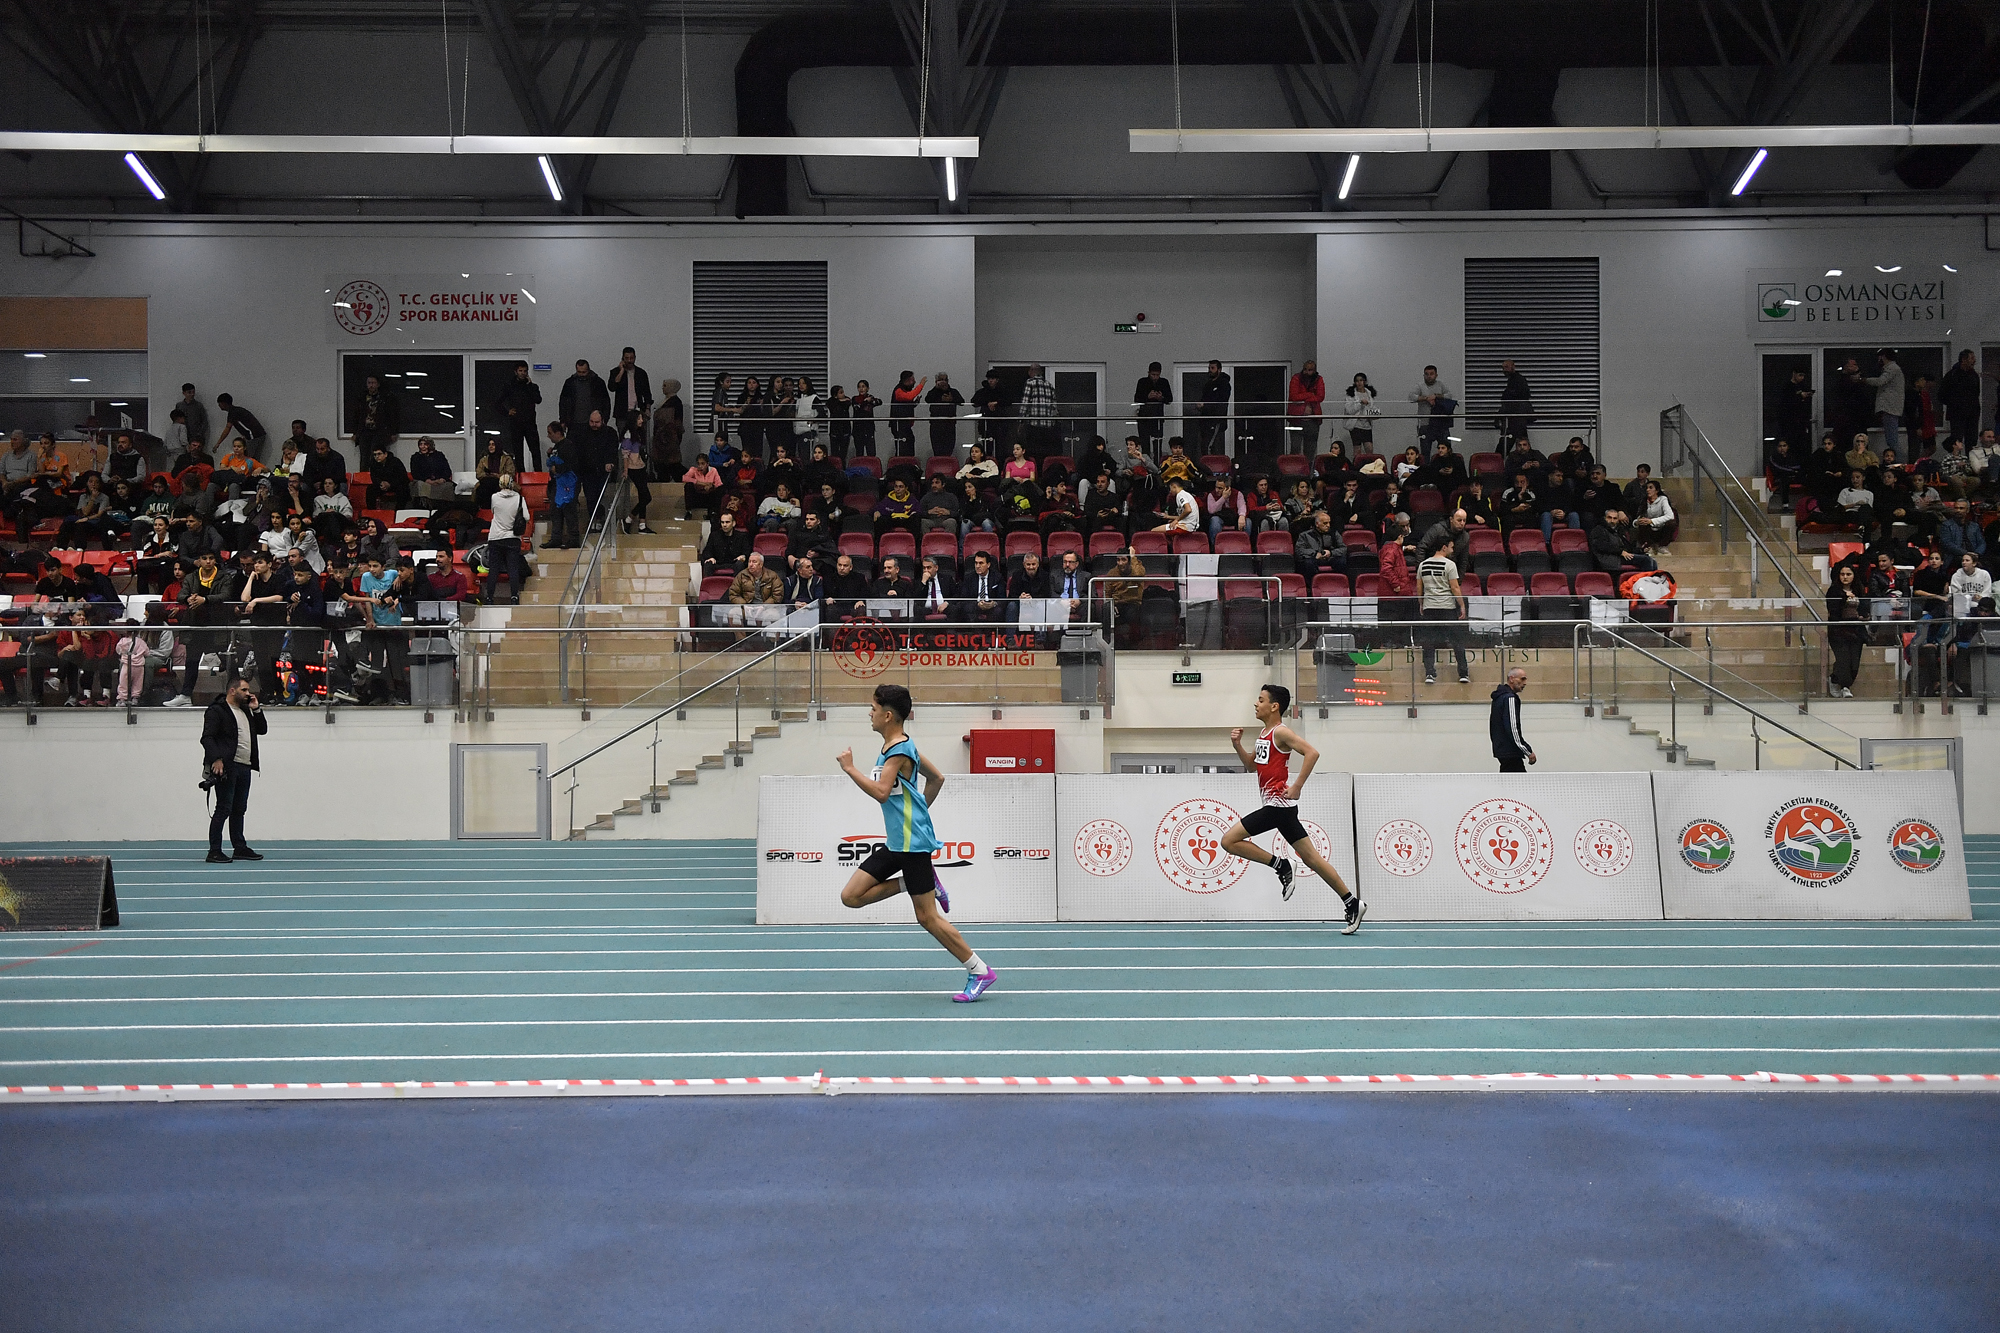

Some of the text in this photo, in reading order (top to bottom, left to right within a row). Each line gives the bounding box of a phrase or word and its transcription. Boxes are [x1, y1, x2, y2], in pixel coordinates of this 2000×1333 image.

[399, 291, 518, 308] T.C. GENÇLİK VE
[1805, 281, 1945, 302] OSMANGAZİ
[399, 307, 519, 322] SPOR BAKANLIĞI
[1806, 304, 1945, 322] BELEDİYESİ
[899, 631, 1036, 650] T.C. GENÇLİK VE
[899, 650, 1036, 667] SPOR BAKANLIĞI
[1406, 647, 1540, 664] BLEDİYESİ
[1193, 815, 1220, 824] GENÇLİK
[1220, 823, 1228, 831] VE
[1764, 810, 1781, 839] TÜRKİYE
[1781, 797, 1813, 812] ATLETİZM
[1493, 815, 1520, 824] GENÇLİK
[1520, 823, 1528, 831] VE
[1526, 830, 1535, 847] SPOR
[1768, 849, 1861, 888] TURKISH ATHLETIC FEDERATION
